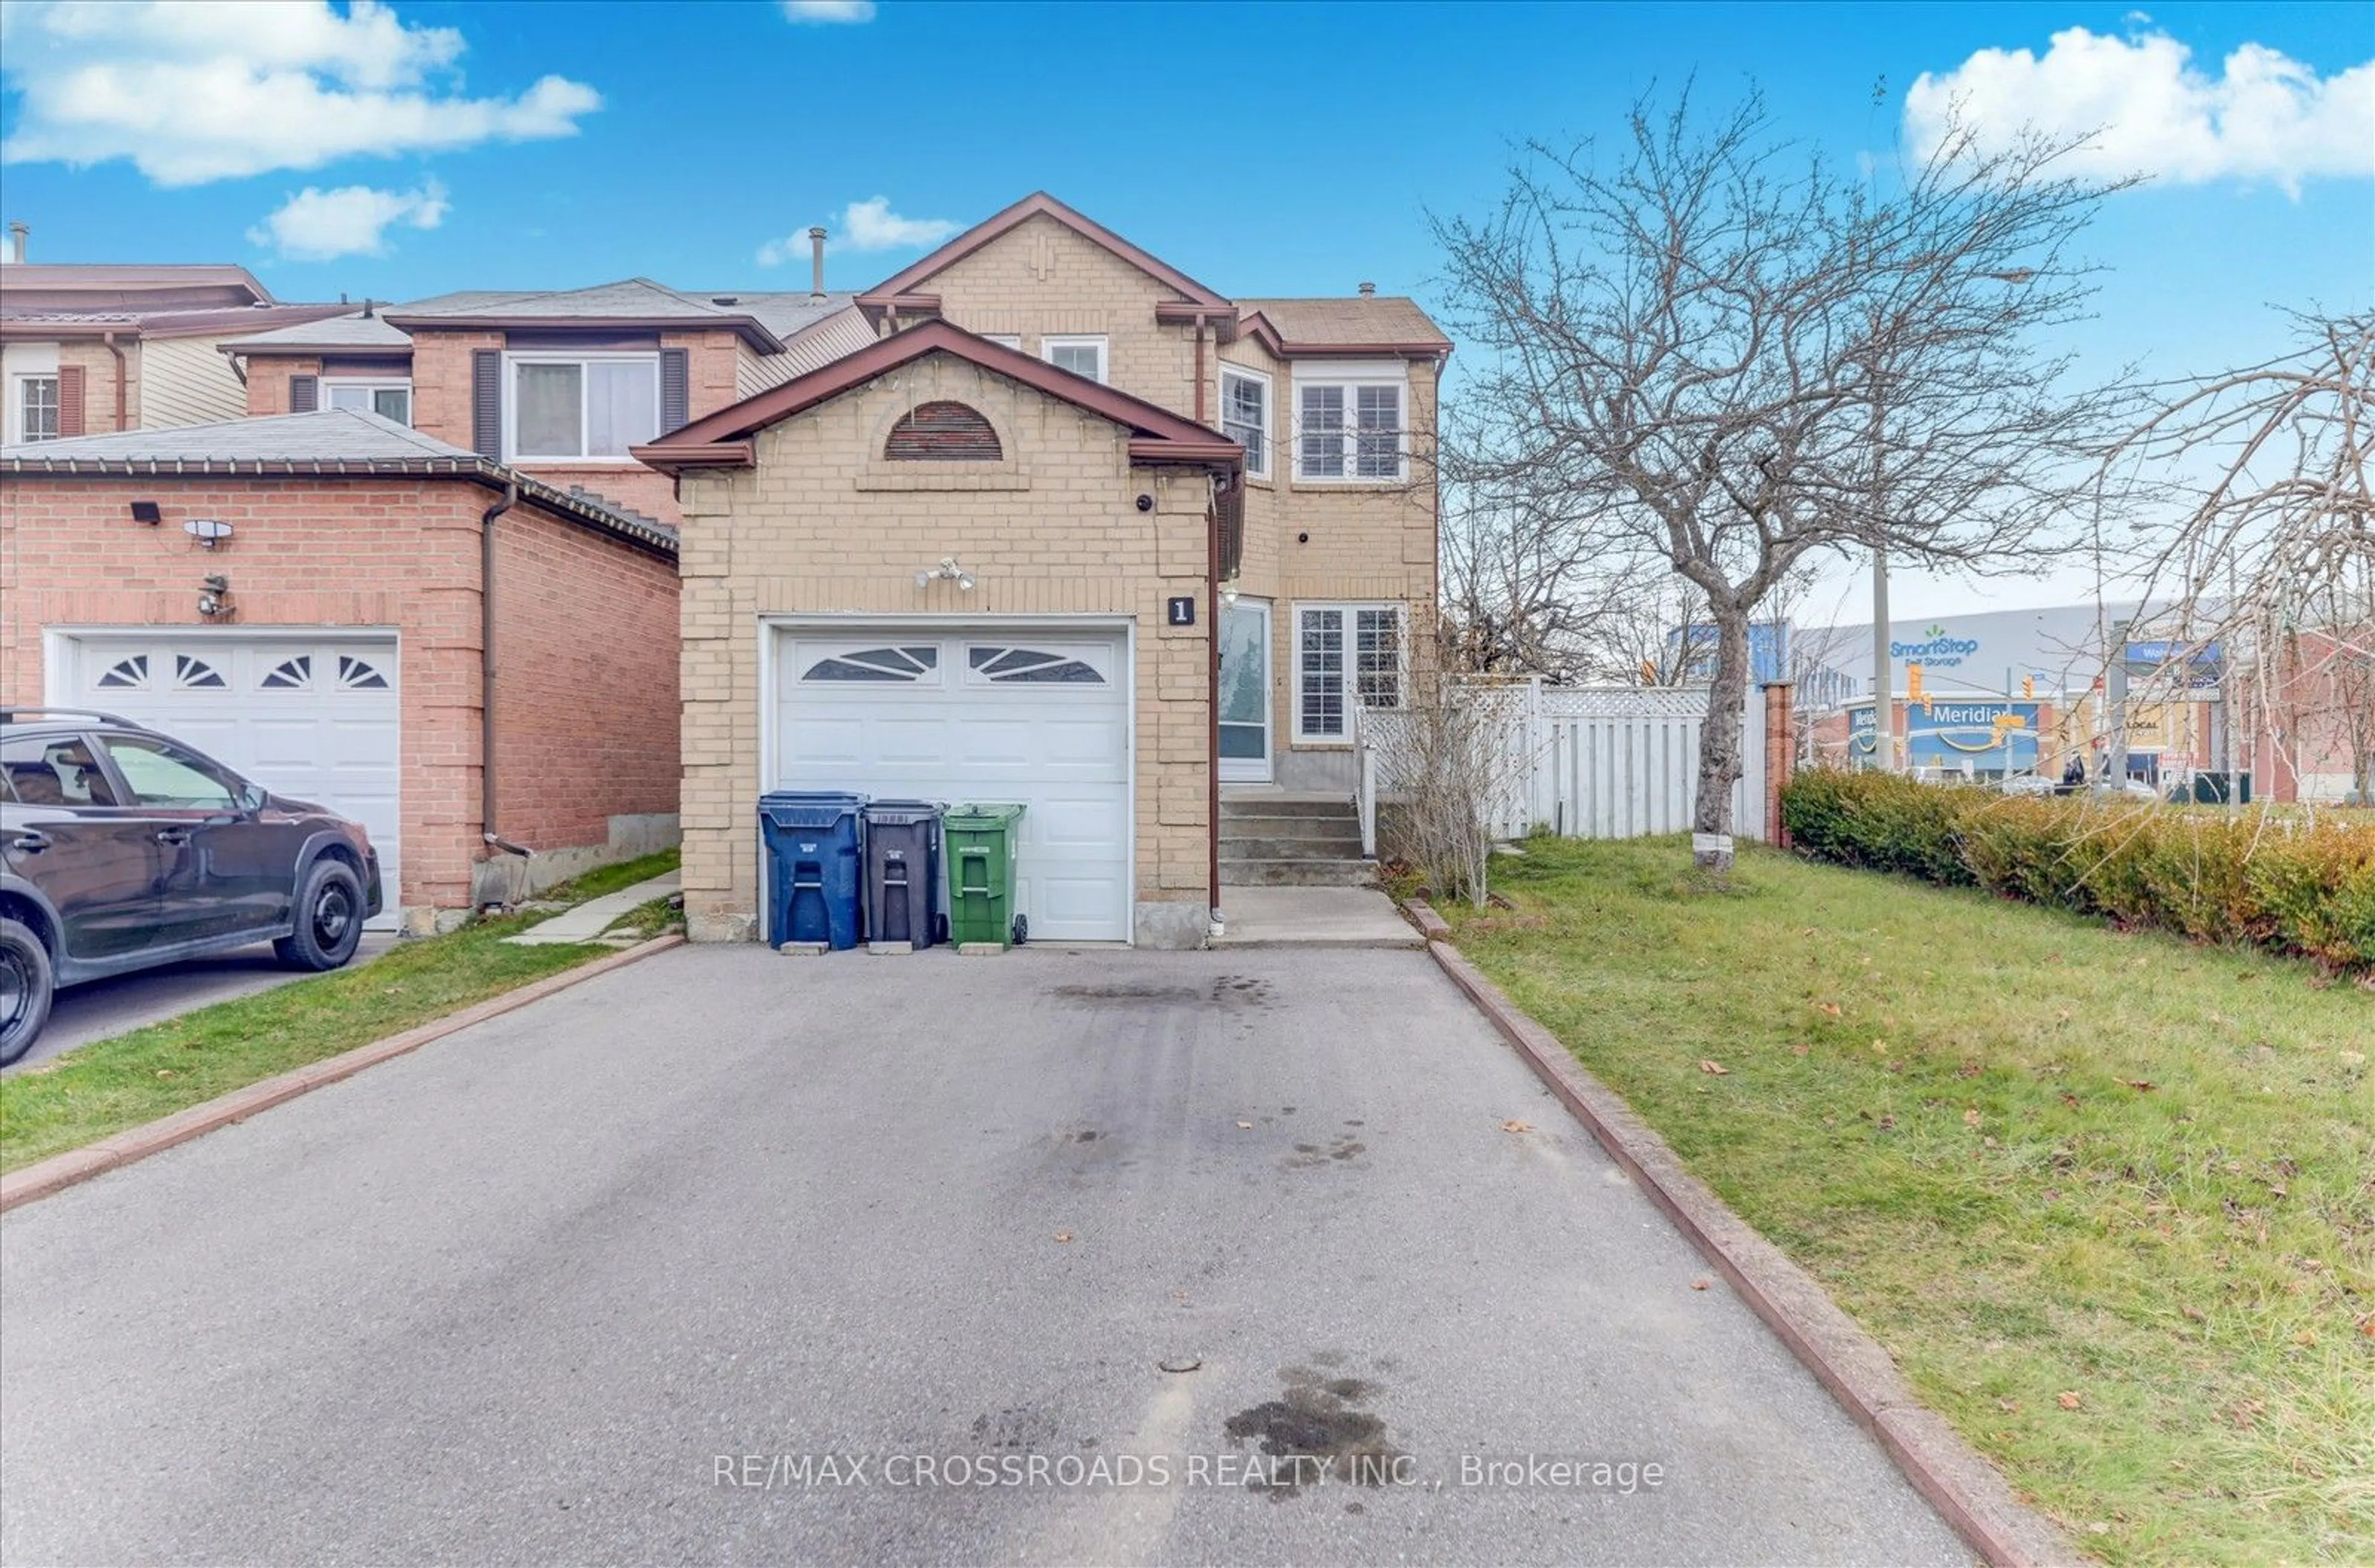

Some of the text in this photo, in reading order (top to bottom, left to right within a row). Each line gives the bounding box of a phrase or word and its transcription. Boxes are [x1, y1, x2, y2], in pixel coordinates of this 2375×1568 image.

[1175, 601, 1187, 621] 1
[1890, 637, 1978, 657] SmartStop
[2126, 721, 2159, 729] LOCAL
